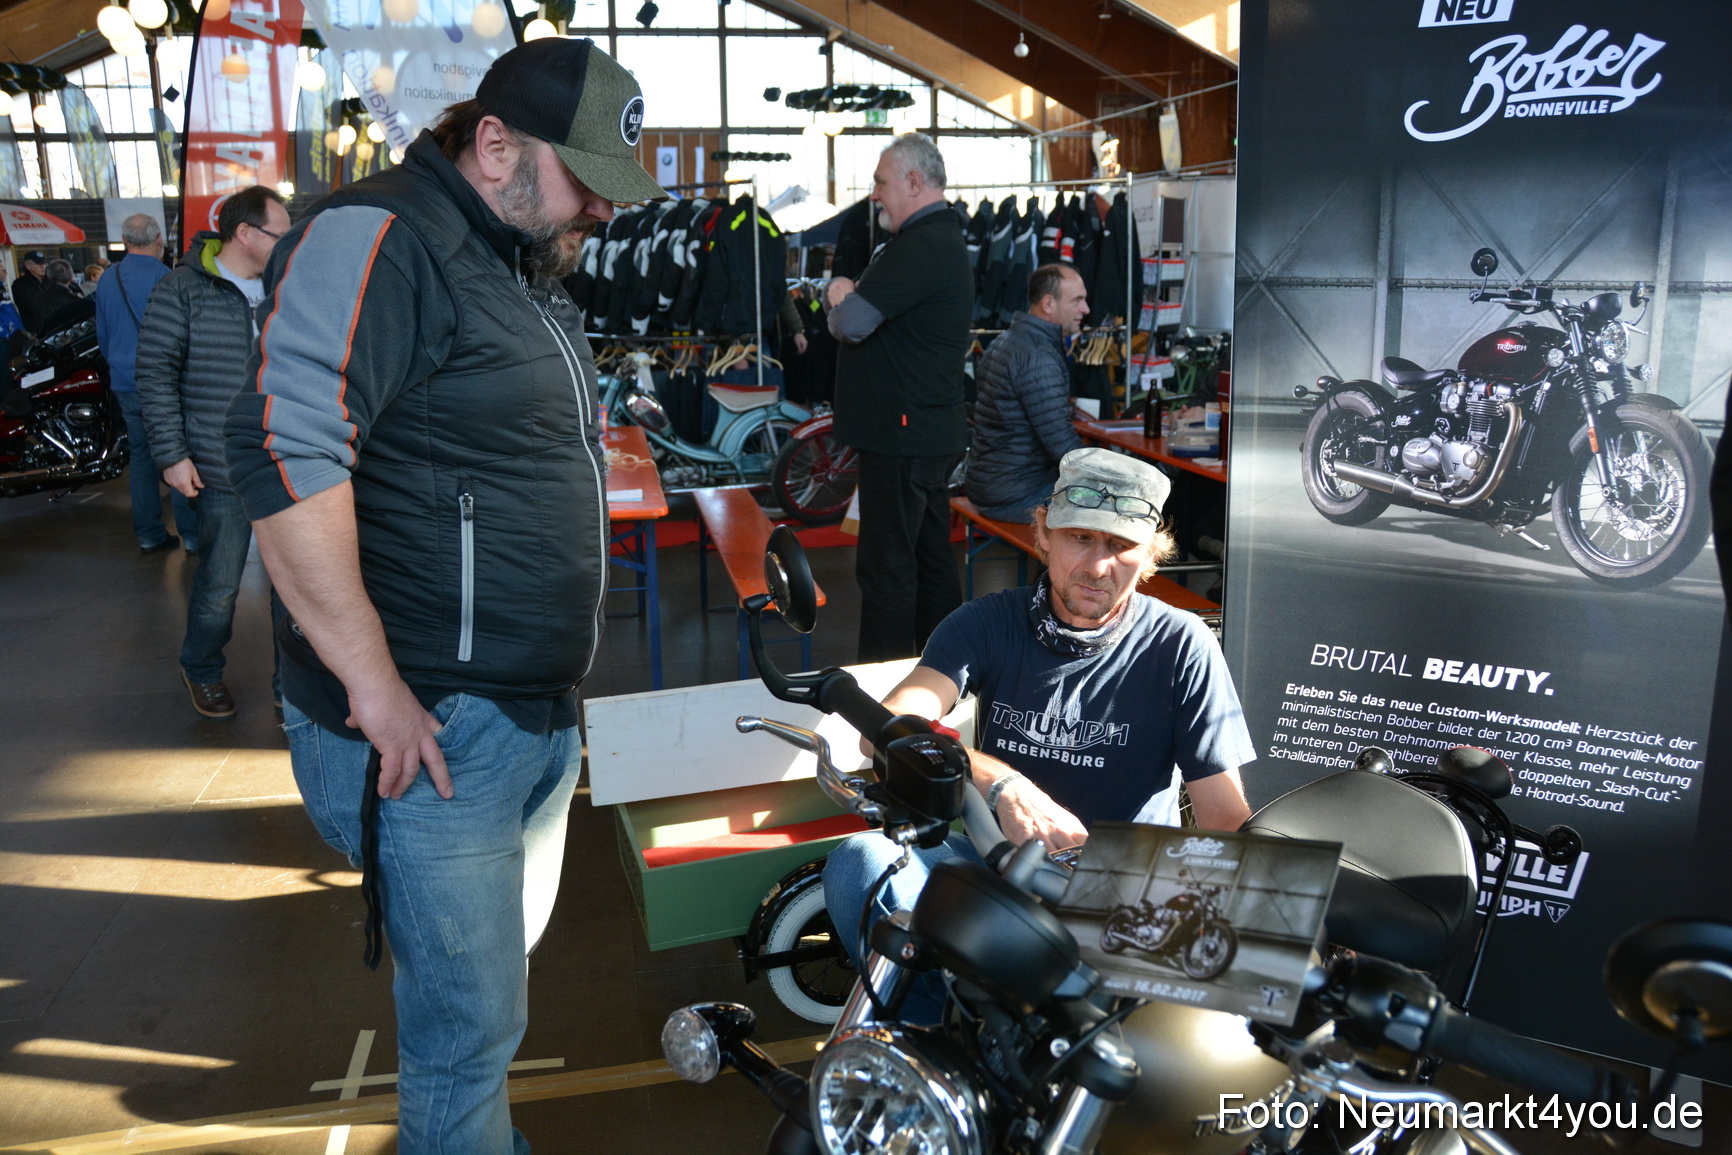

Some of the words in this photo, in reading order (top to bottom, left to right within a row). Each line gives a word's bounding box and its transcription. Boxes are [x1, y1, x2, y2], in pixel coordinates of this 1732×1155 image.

[1434, 0, 1498, 23] NEU
[1403, 24, 1667, 142] Bobber
[1504, 99, 1610, 119] BONNEVILLE
[12, 222, 50, 230] YAMAHA
[1497, 343, 1528, 354] TRIUMPH
[1310, 643, 1412, 678] BRUTAL
[1422, 657, 1555, 696] BEAUTY.
[992, 701, 1130, 750] TRIUMPH
[1281, 701, 1383, 724] minimalistischen
[1387, 713, 1434, 731] Bobber
[1437, 721, 1474, 737] bildet
[1477, 727, 1502, 741] der
[1505, 730, 1540, 746] 1.200
[1576, 740, 1704, 770] Bonneville-Motor
[1285, 682, 1334, 700] Erleben
[1338, 689, 1358, 703] Sie
[1361, 693, 1386, 707] das
[1390, 698, 1423, 712] neue
[1427, 702, 1582, 735] Custom-Werksmodell:
[1585, 724, 1665, 747] Herzstück
[1668, 736, 1698, 751] der
[996, 738, 1105, 768] REGENSBURG
[1273, 730, 1288, 742] im
[1292, 735, 1343, 751] unteren
[1518, 768, 1591, 789] doppelten
[1277, 716, 1297, 729] mit
[1301, 718, 1329, 733] dem
[1333, 722, 1379, 740] besten
[1579, 760, 1619, 776] mehr
[1622, 766, 1692, 789] Leistung
[1526, 786, 1625, 813] Hotrod-Sound.
